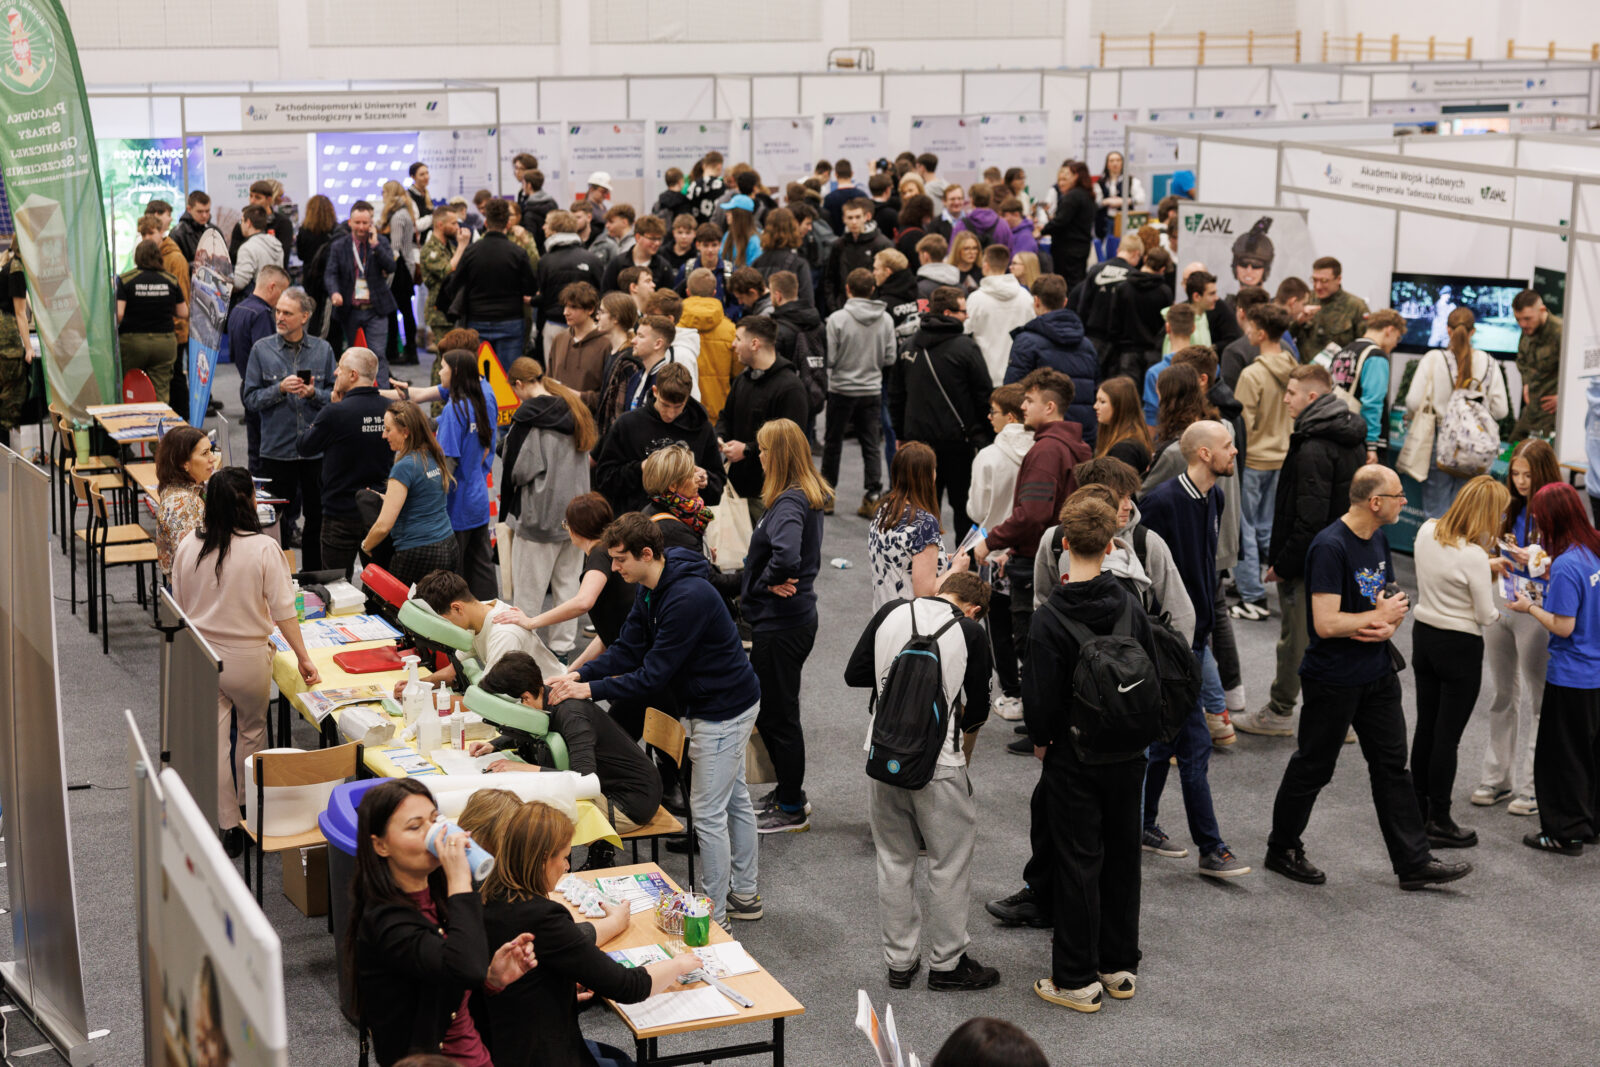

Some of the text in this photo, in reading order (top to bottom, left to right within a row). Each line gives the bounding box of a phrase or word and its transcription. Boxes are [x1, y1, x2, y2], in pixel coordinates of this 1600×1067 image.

[274, 101, 417, 112] Zachodniopomorski Uniwersytet
[286, 112, 352, 122] Technologiczny
[364, 112, 407, 120] Szczecinie
[228, 170, 288, 181] maturzystów
[1361, 165, 1466, 190] Akademia Wojsk Lądowych
[1406, 187, 1437, 199] Tadeusza
[1438, 191, 1475, 205] Kościuszki
[1200, 215, 1233, 234] AWL
[361, 424, 386, 433] SZCZEC
